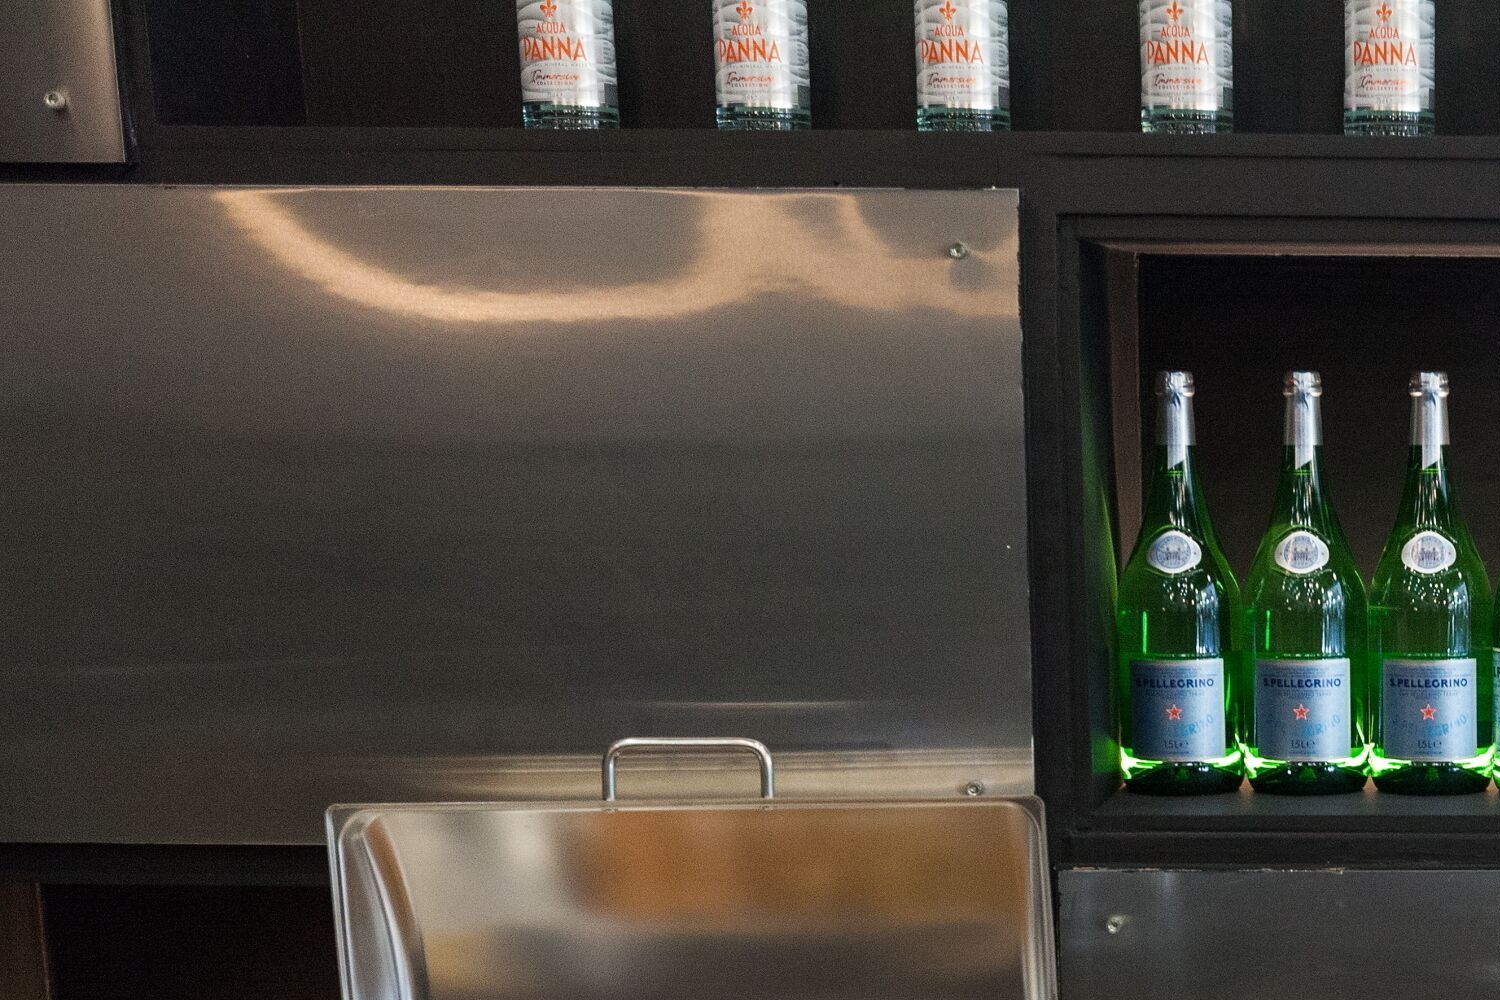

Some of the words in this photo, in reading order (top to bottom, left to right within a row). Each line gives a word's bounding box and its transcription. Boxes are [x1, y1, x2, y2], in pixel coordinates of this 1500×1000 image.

[536, 22, 566, 33] ACQUA
[731, 24, 761, 36] ACQUA
[934, 25, 964, 37] ACQUA
[1161, 26, 1190, 37] ACQUA
[1369, 27, 1400, 39] ACQUA
[524, 35, 587, 61] PANNA
[719, 38, 782, 62] PANNA
[921, 39, 984, 64] PANNA
[1146, 40, 1208, 64] PANNA
[1353, 41, 1417, 66] PANNA
[1263, 678, 1342, 689] S.PELLEGRINO
[1389, 678, 1468, 689] S.PELLEGRINO
